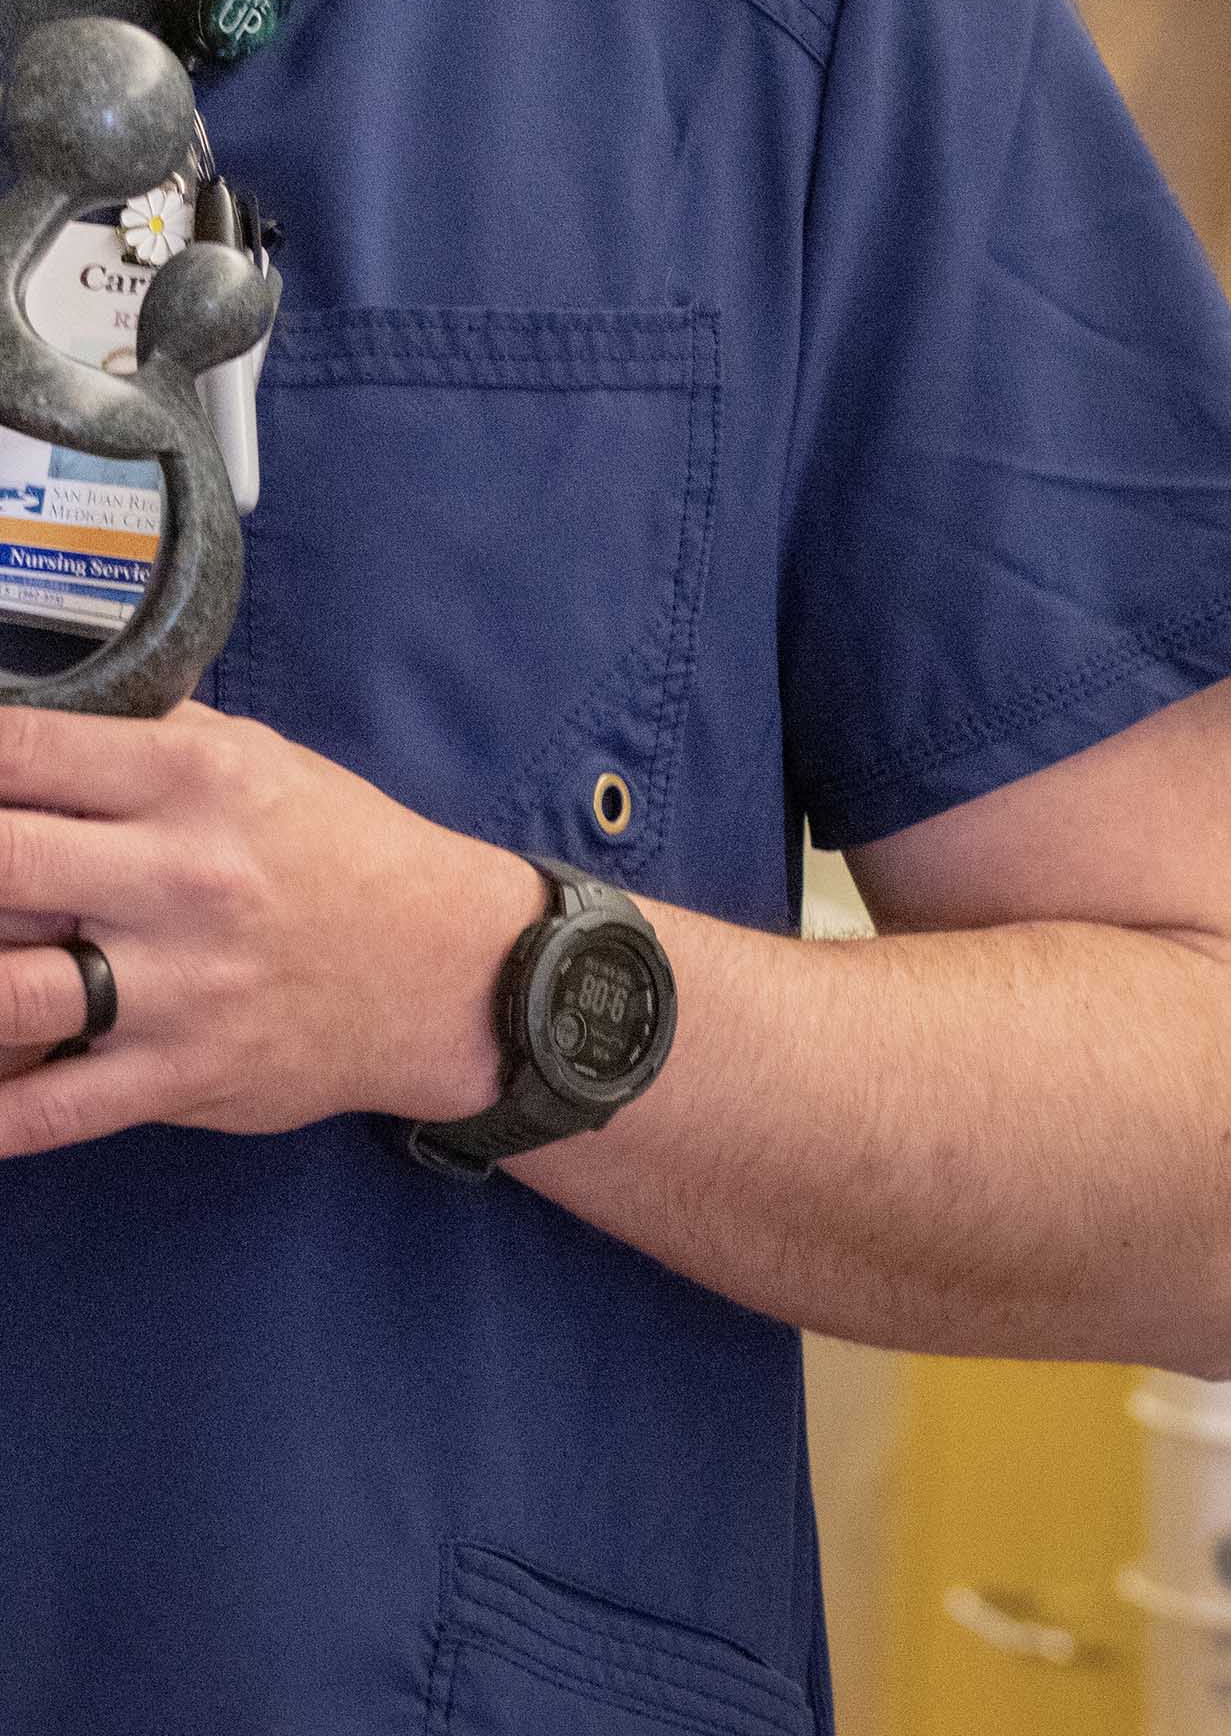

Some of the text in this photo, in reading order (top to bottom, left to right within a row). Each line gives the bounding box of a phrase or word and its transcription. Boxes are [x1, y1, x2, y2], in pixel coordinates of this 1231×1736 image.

[80, 263, 148, 294] Car
[53, 487, 80, 504] SAN
[87, 490, 123, 508] JUAN
[50, 503, 115, 525] MEDICAL
[10, 546, 87, 577] Nursing
